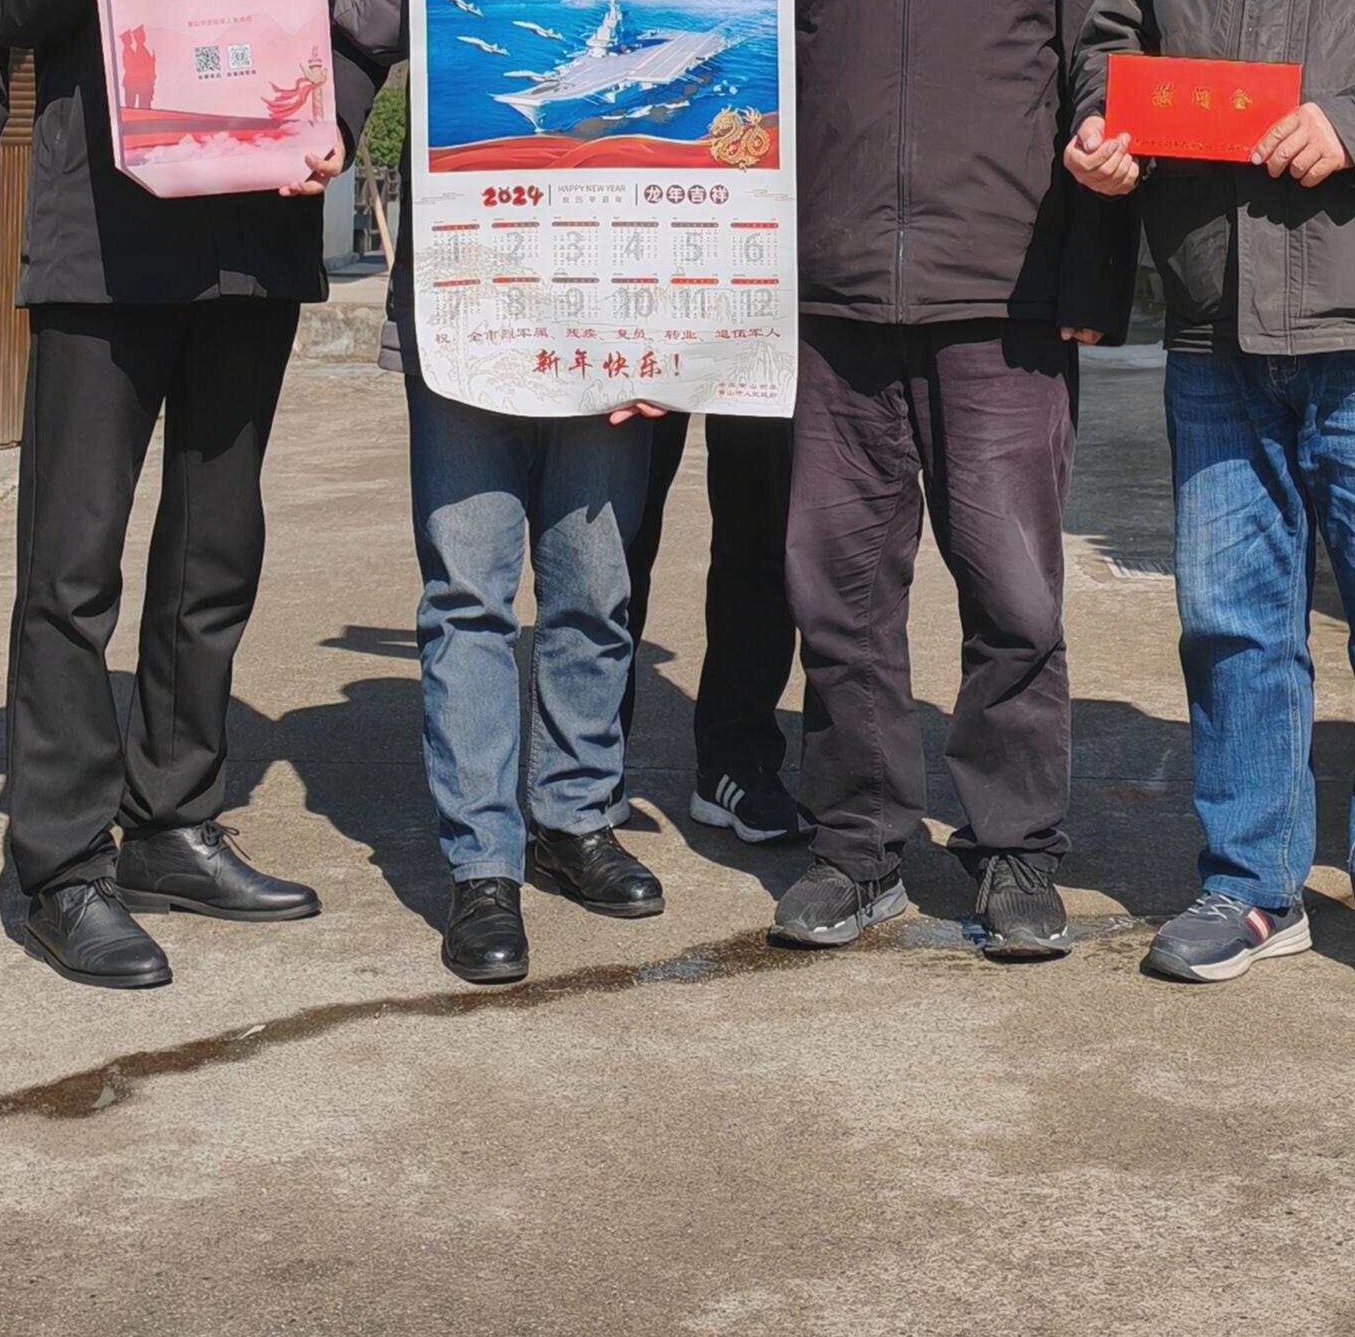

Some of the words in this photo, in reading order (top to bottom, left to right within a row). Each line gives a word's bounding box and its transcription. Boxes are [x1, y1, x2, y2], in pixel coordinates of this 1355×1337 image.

[482, 185, 544, 207] 2024
[557, 184, 585, 193] HAPPY
[585, 184, 605, 193] NEW
[606, 184, 627, 193] YEAR
[644, 184, 730, 205] 龙年吉祥
[506, 231, 525, 262] 2
[565, 231, 583, 262] 3
[624, 231, 641, 261] 4
[685, 231, 703, 262] 5
[744, 232, 764, 262] 6
[506, 287, 526, 316] 8
[565, 287, 584, 316] 9
[741, 288, 774, 317] 12
